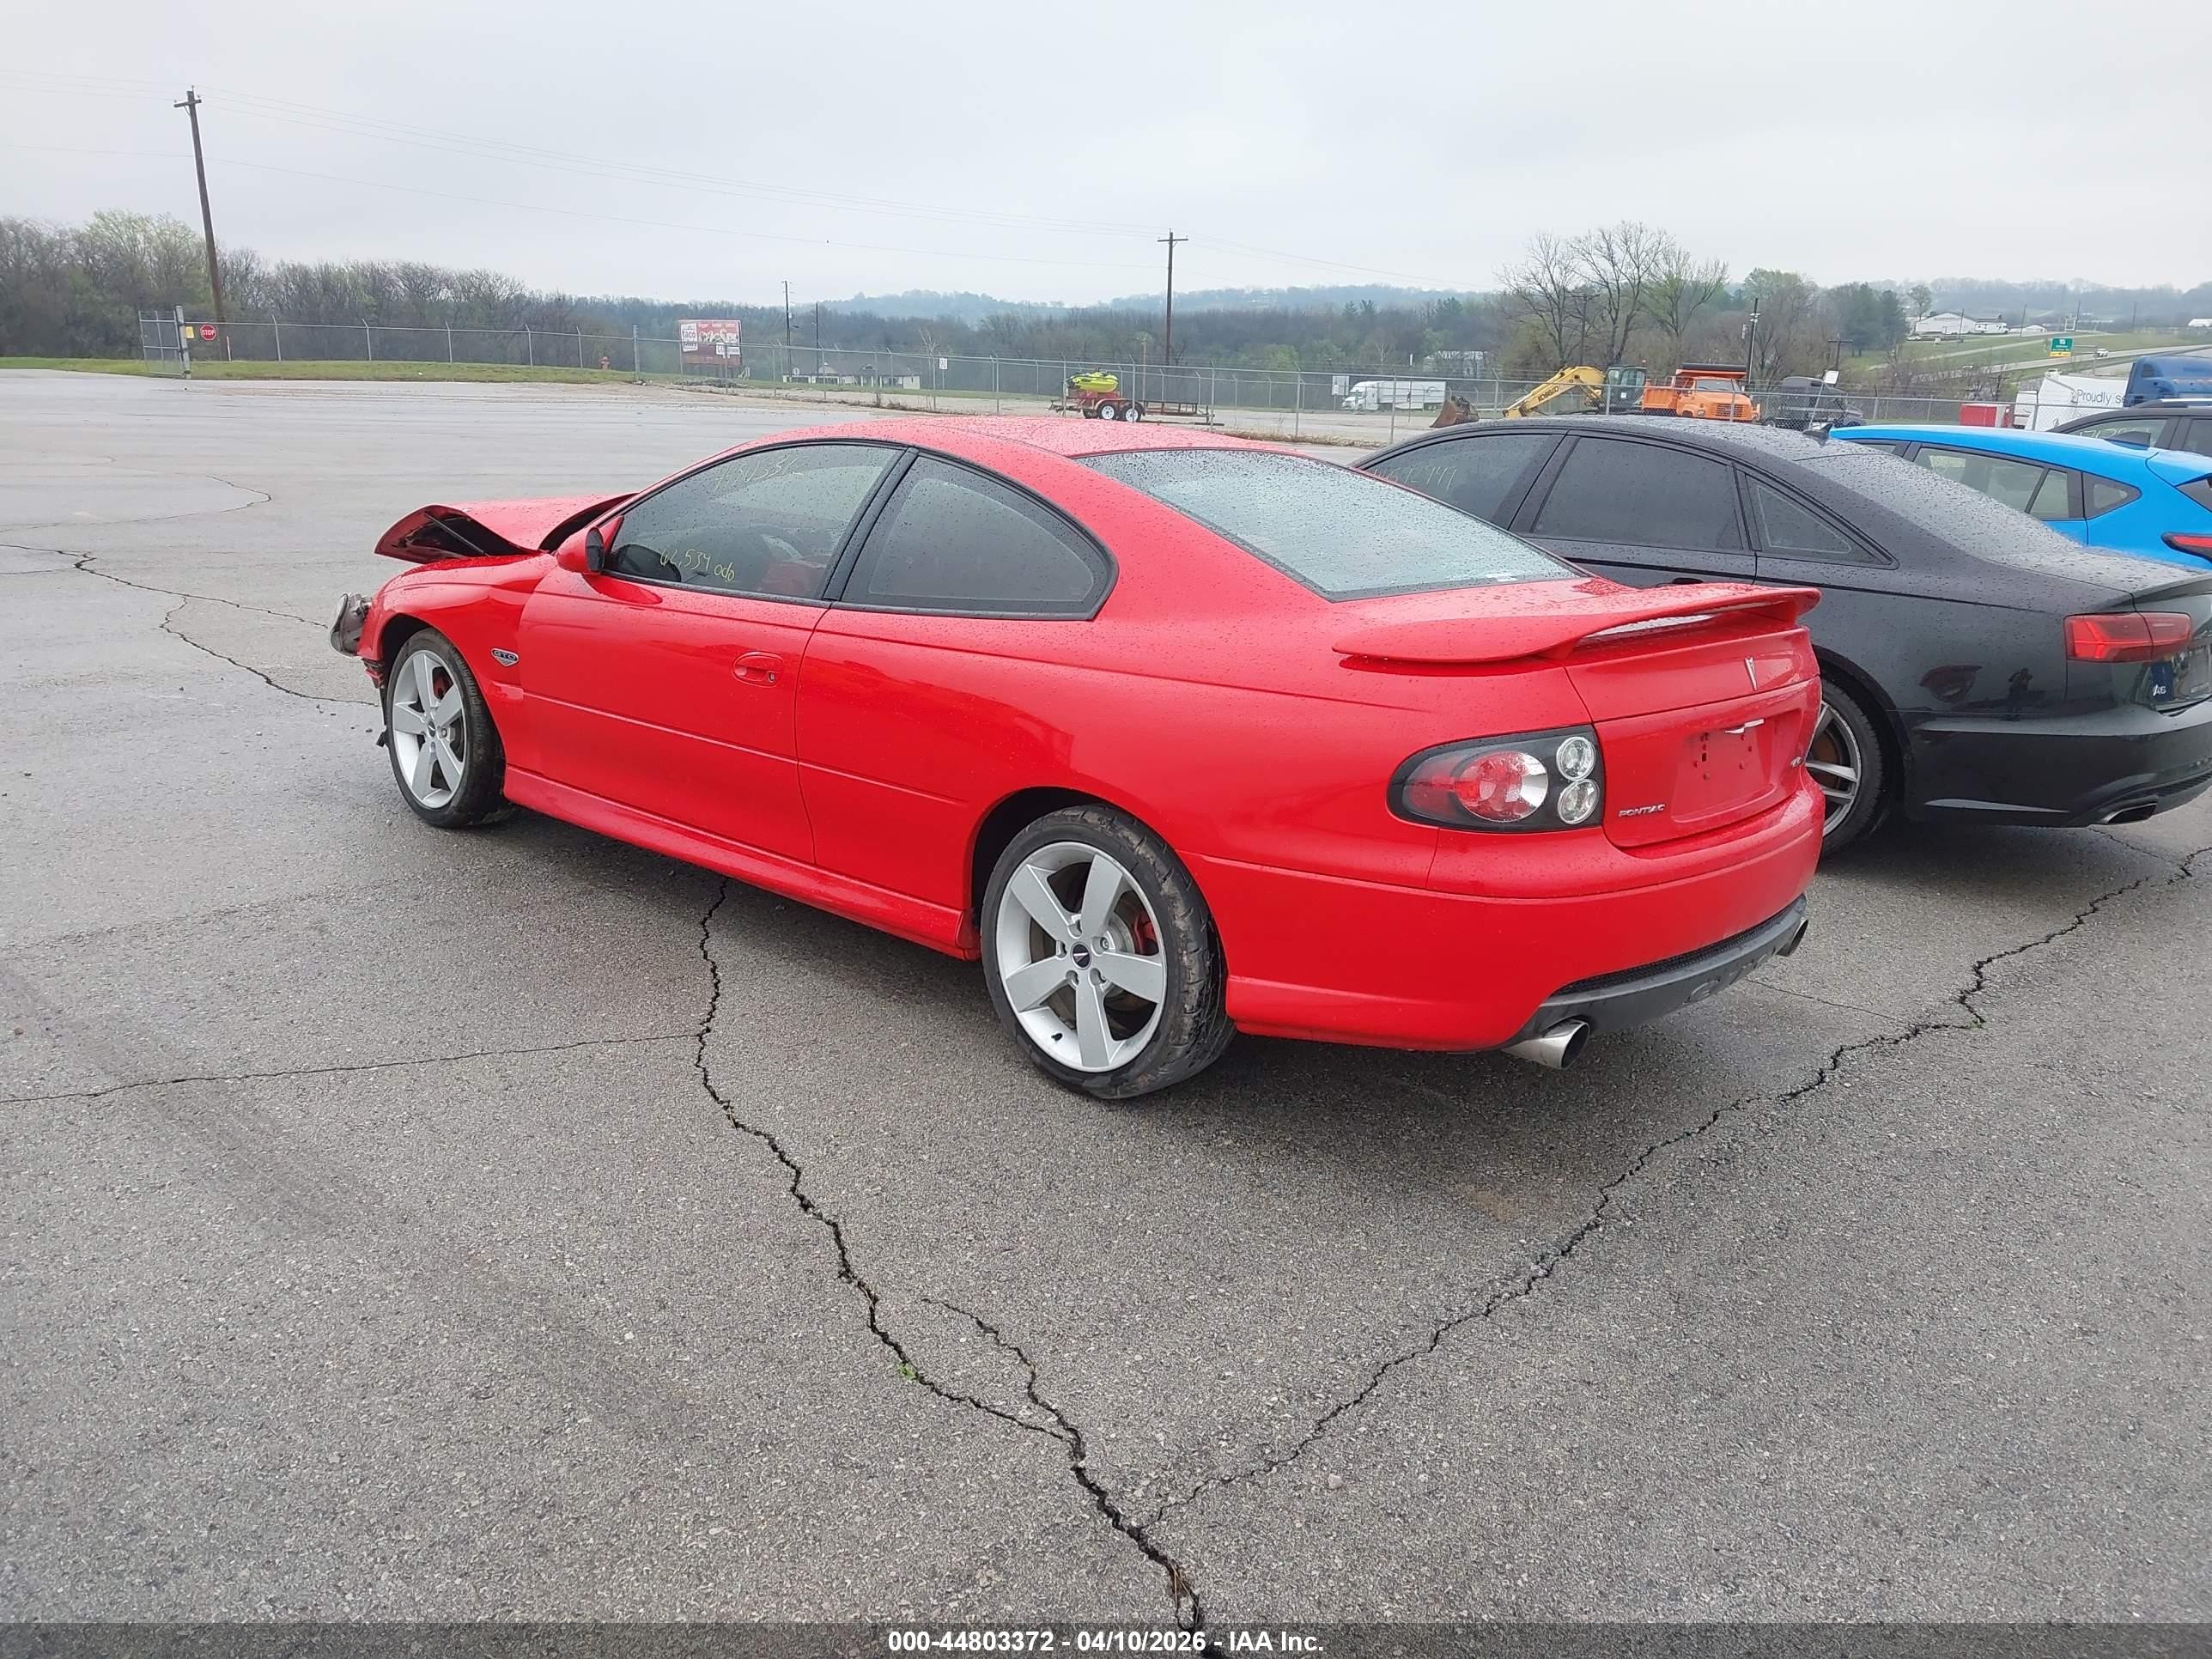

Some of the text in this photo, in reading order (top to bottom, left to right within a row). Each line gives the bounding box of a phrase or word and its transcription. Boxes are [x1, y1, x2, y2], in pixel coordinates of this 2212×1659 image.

[2076, 388, 2112, 406] Proudly
[714, 562, 735, 581] odo
[493, 650, 517, 661] GTO
[2152, 684, 2167, 696] A6
[1618, 804, 1666, 817] PONTIAC
